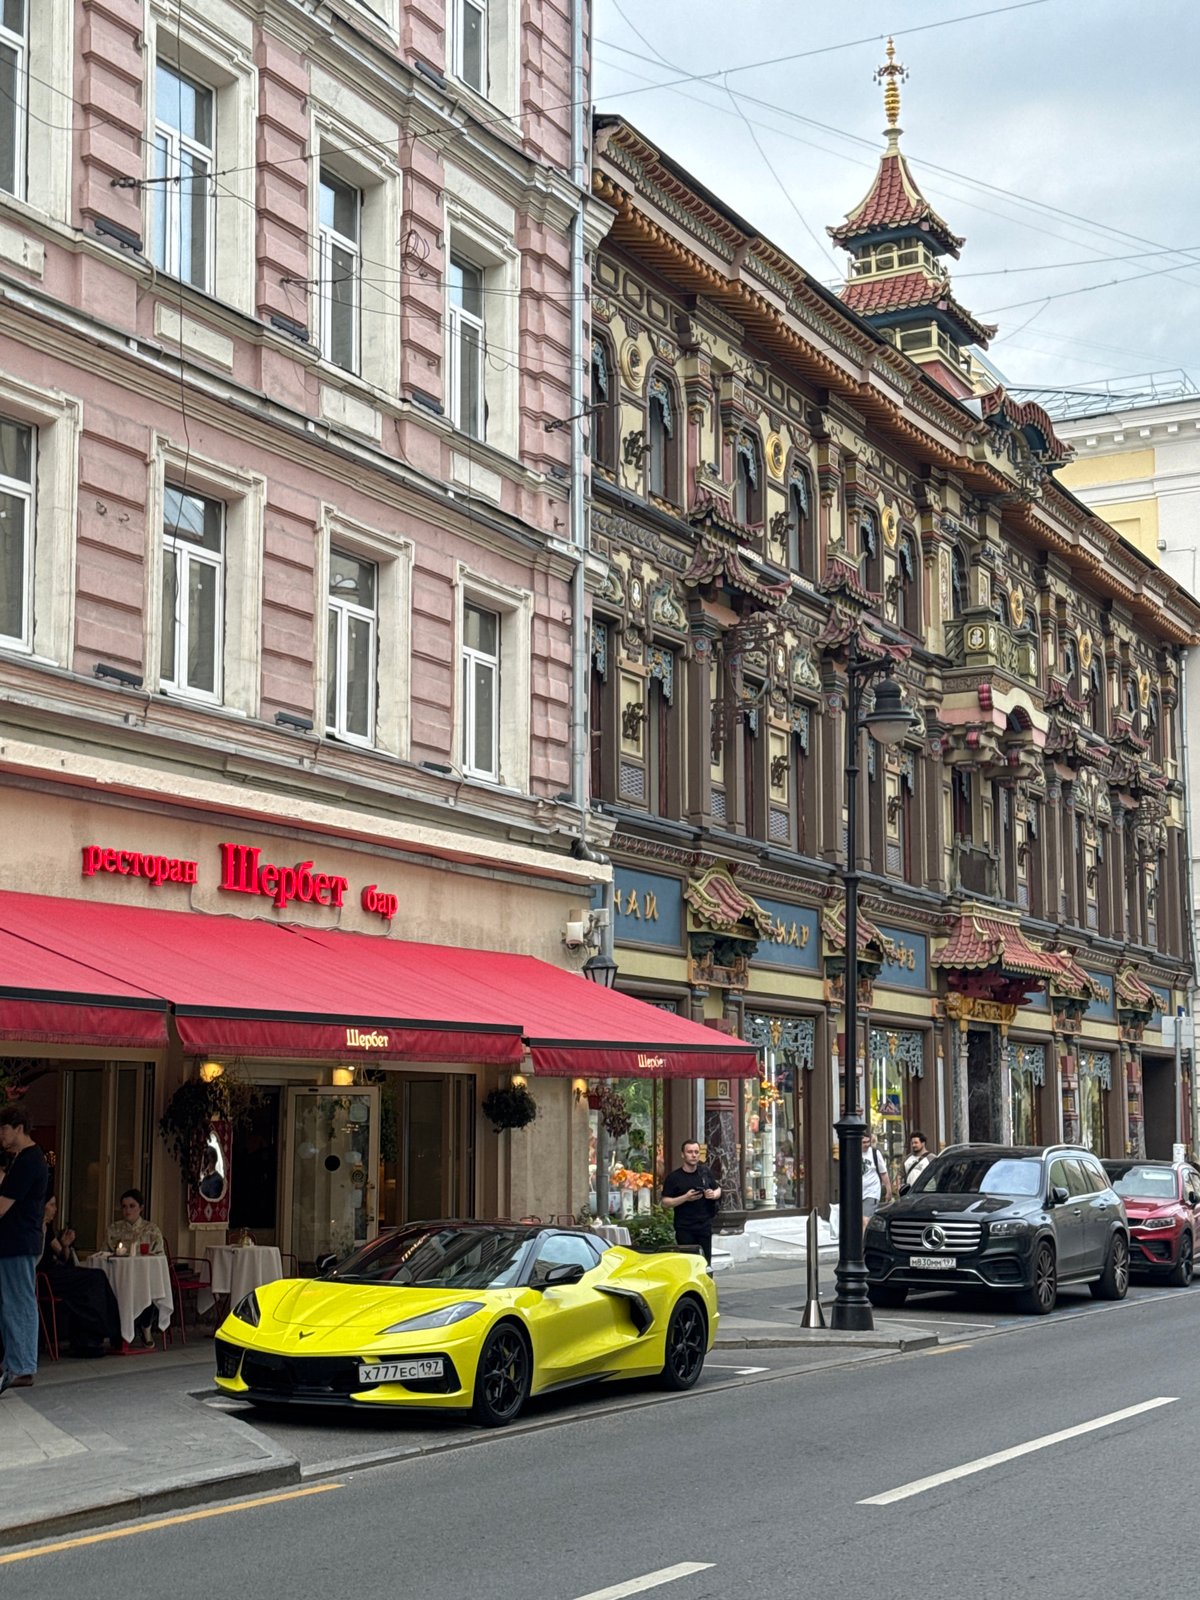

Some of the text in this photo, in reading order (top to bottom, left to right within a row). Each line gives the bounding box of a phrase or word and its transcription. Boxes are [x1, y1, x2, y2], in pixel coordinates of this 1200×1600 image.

[82, 843, 398, 920] ресторан Шербет бар
[346, 1029, 389, 1050] Шербет
[637, 1054, 667, 1071] Шербет
